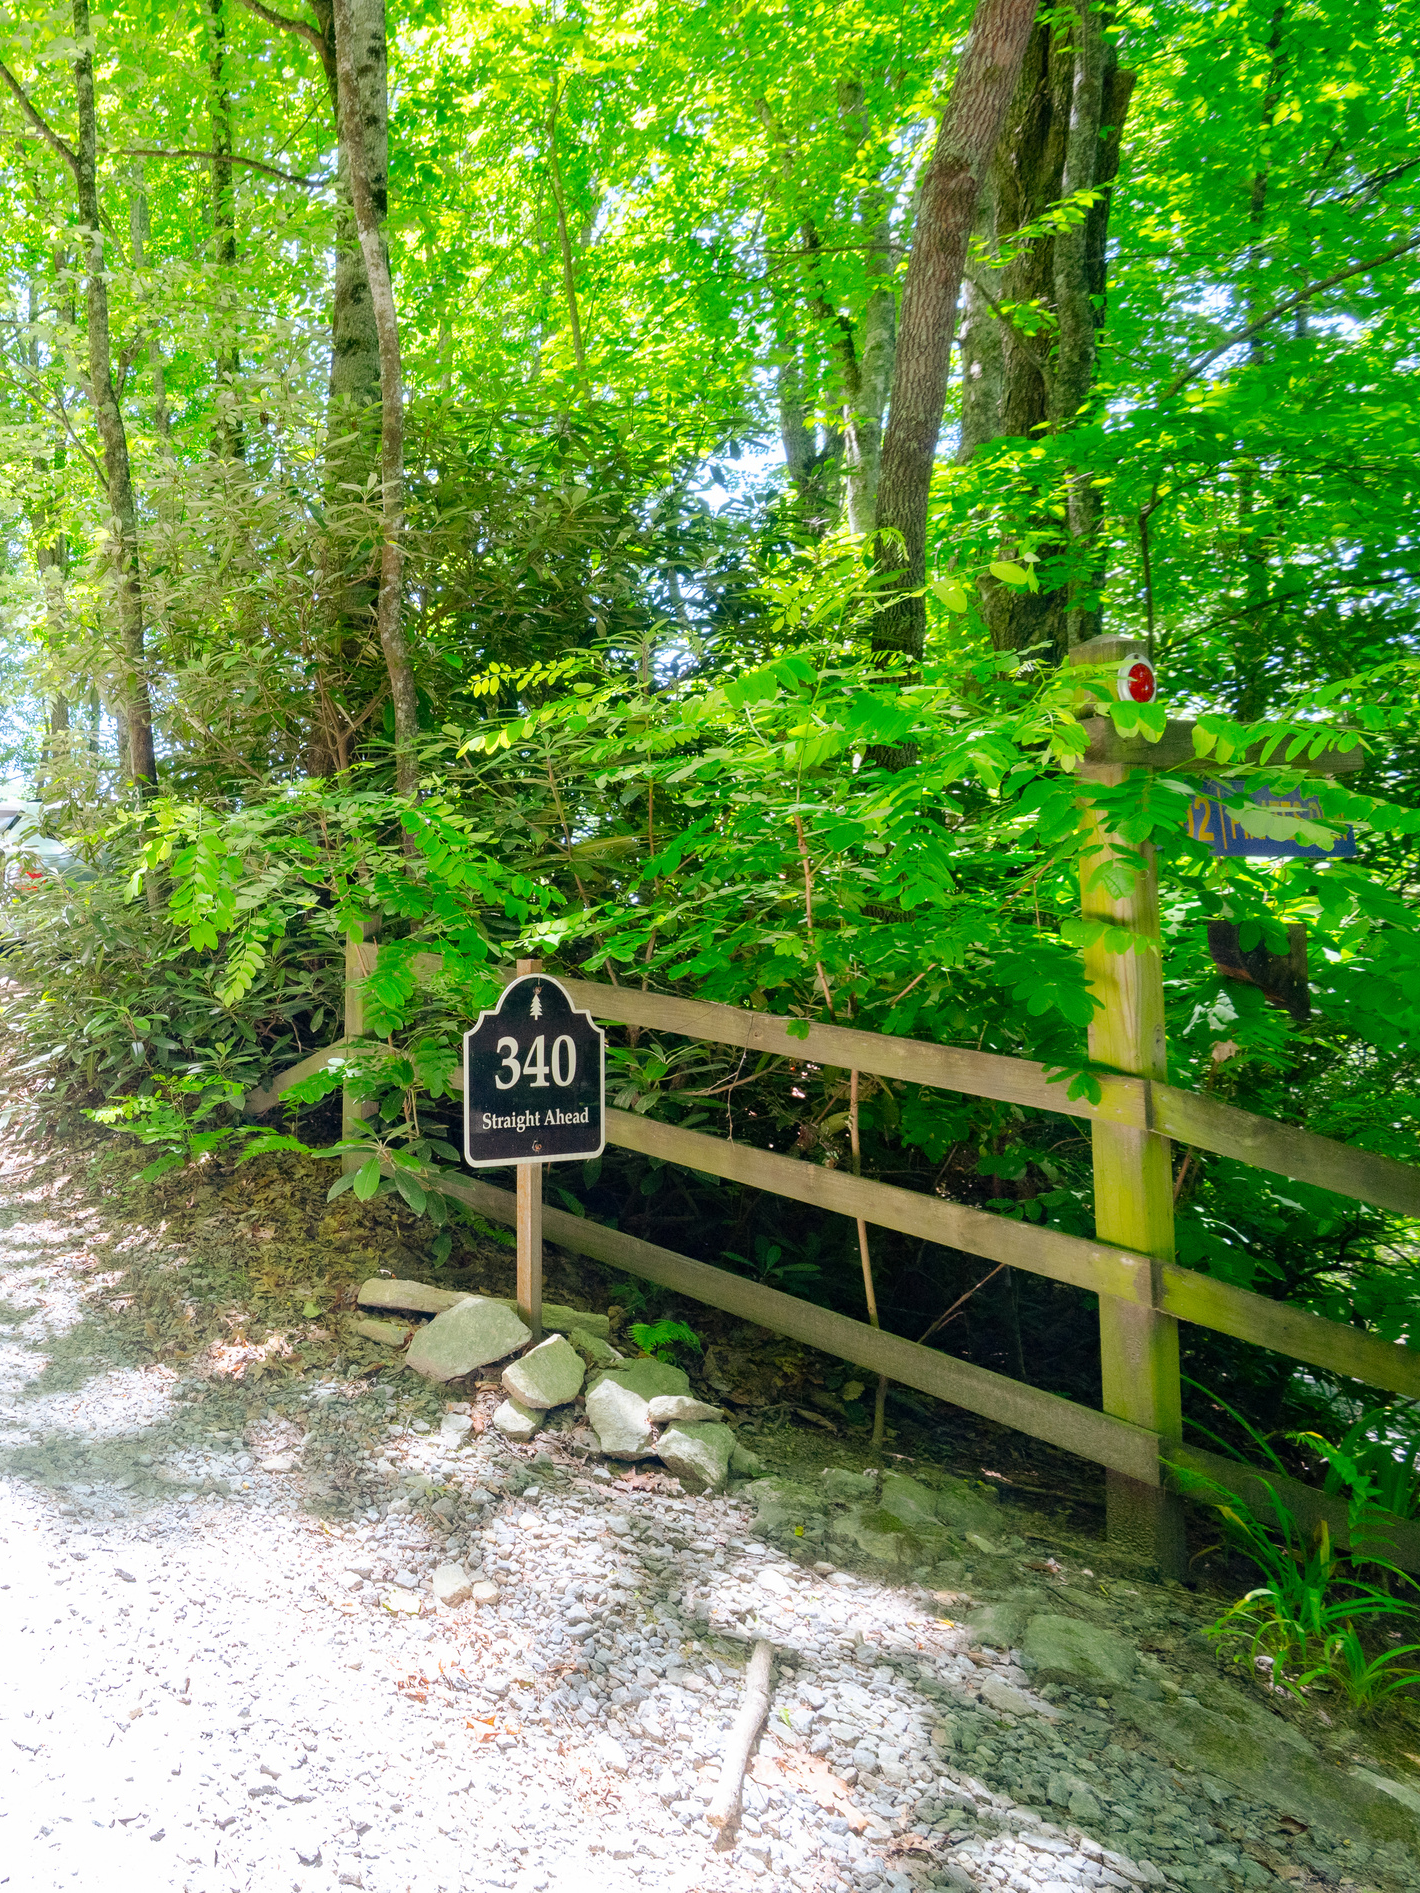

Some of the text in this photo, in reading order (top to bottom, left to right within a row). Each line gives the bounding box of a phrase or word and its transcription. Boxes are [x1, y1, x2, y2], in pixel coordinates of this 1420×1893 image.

[494, 1034, 577, 1090] 340
[482, 1107, 590, 1133] Straight Ahead
